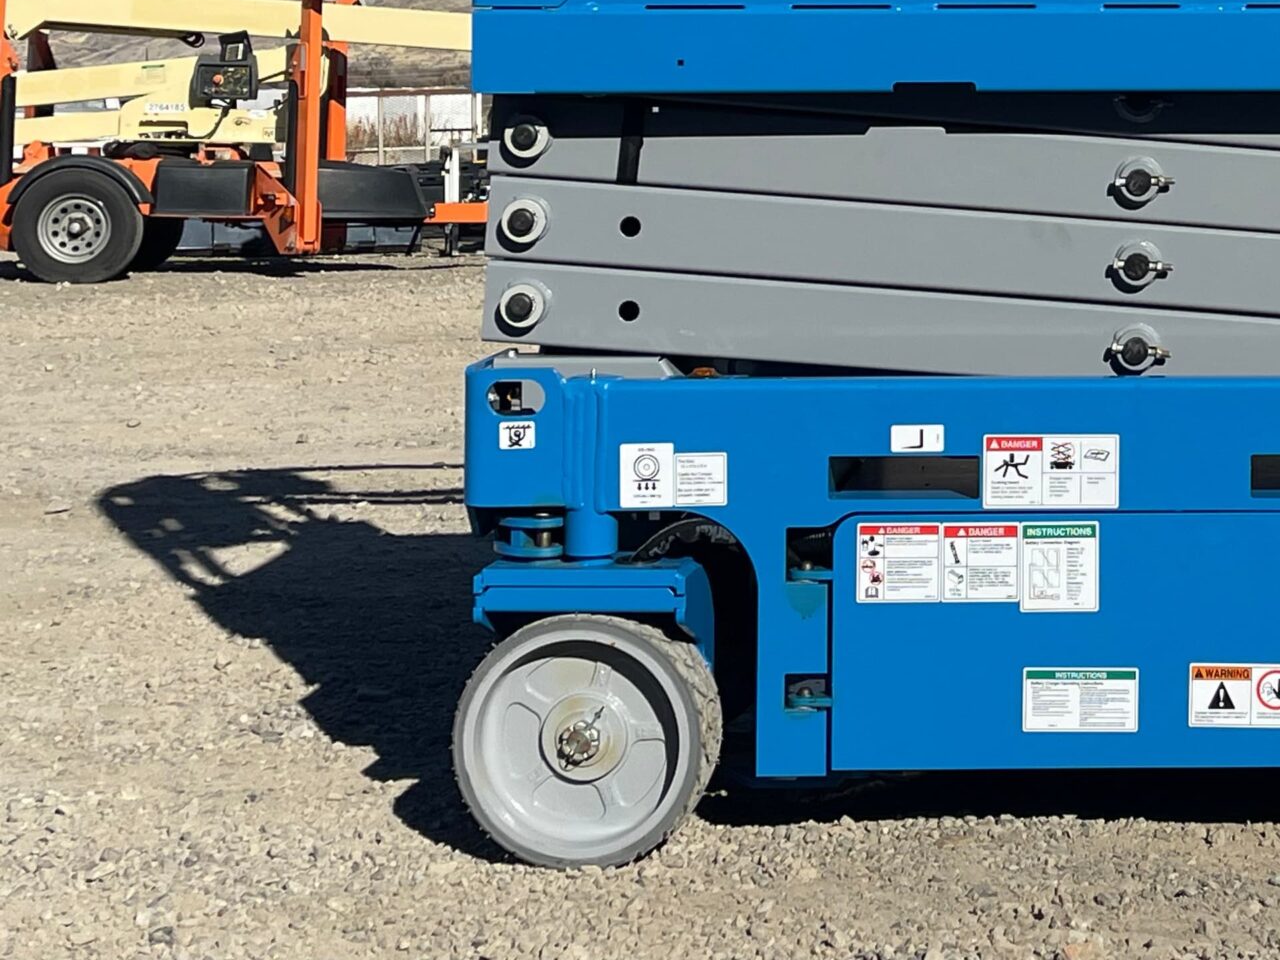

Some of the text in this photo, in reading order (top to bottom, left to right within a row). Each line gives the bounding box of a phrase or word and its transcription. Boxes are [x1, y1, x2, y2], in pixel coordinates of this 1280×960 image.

[1000, 440, 1038, 449] DANGER
[886, 526, 921, 534] DANGER
[967, 527, 1005, 536] DANGER
[1026, 527, 1093, 536] INSTRUCTIONS
[1204, 668, 1250, 679] WARNING
